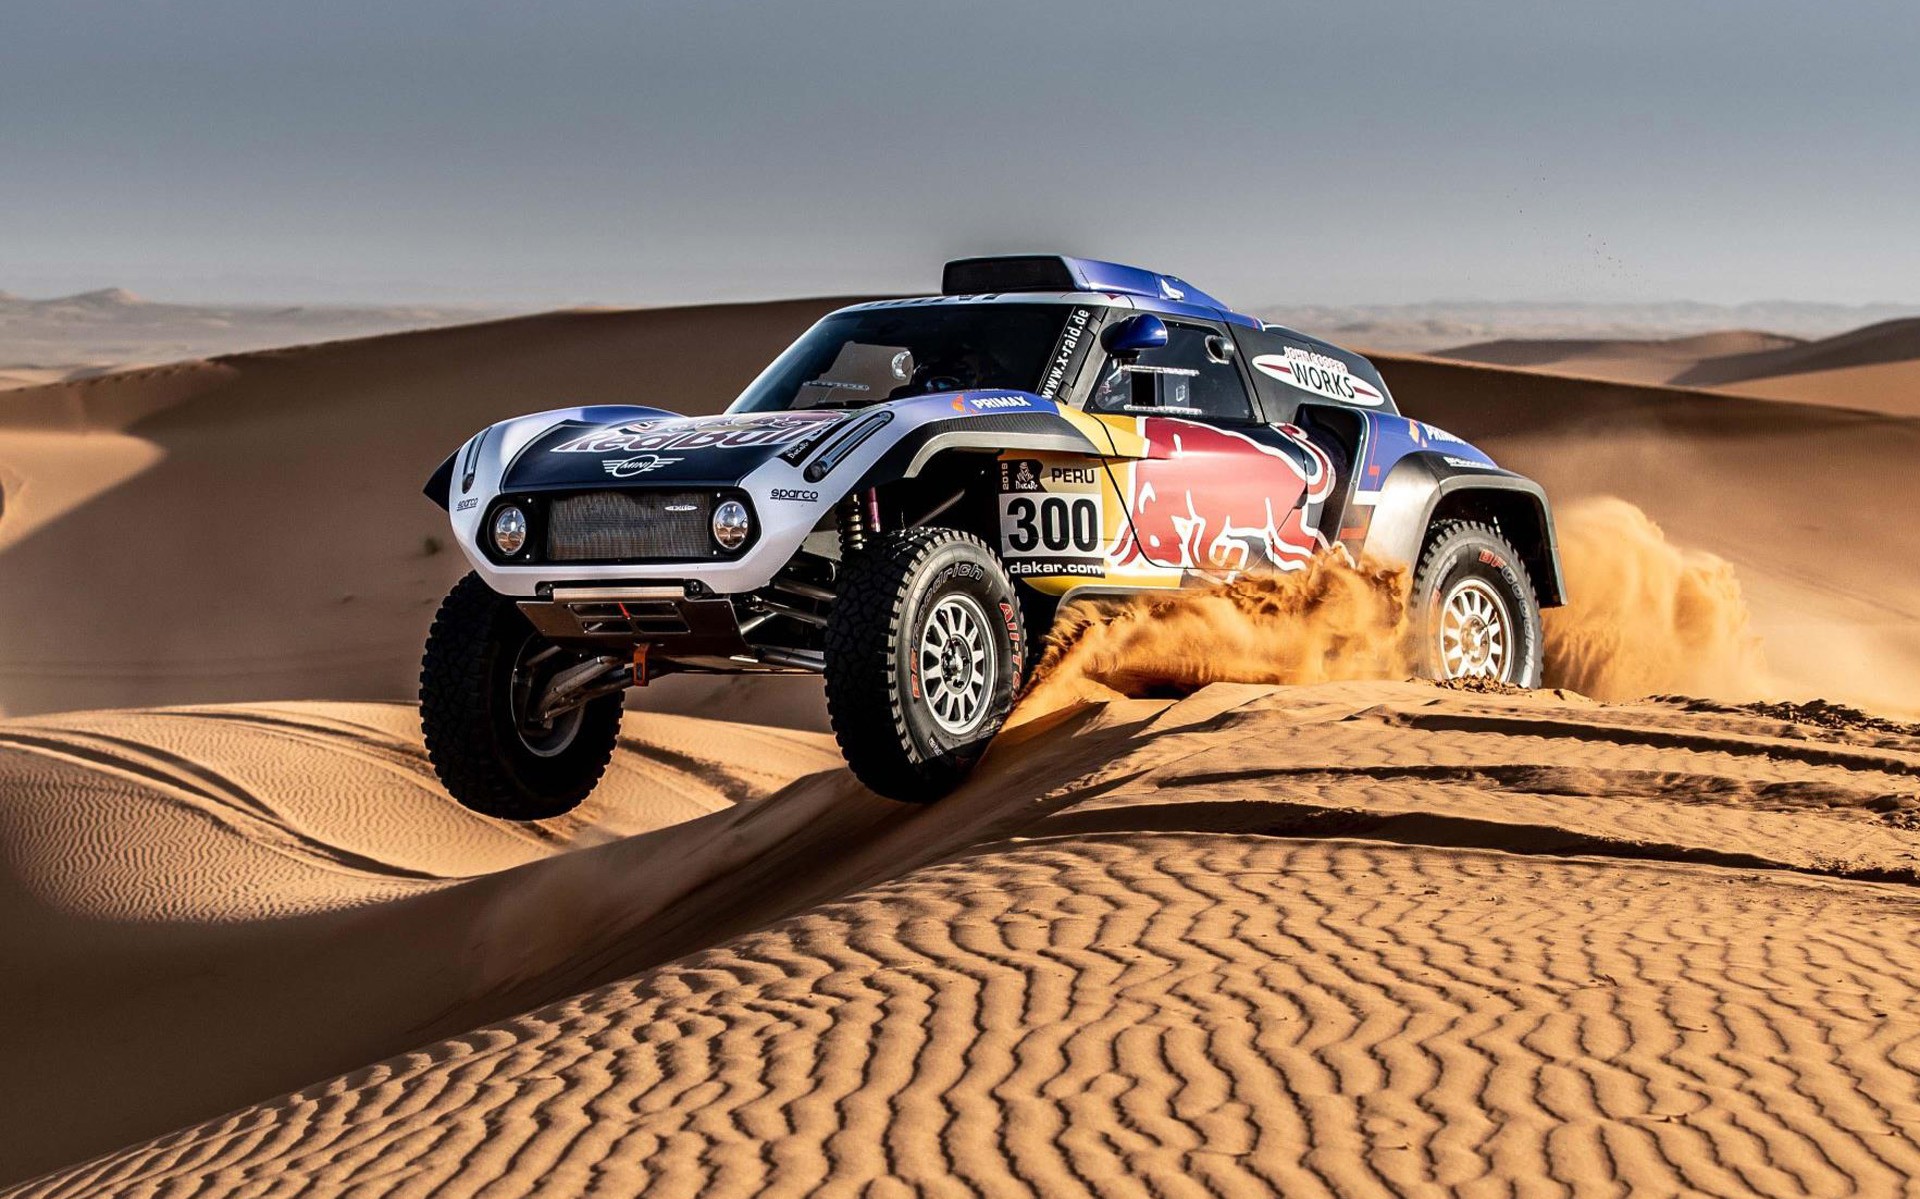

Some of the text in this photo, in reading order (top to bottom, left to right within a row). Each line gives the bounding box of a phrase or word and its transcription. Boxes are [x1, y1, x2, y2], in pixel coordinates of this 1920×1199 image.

[1041, 309, 1090, 400] www.x-raid.de
[1283, 346, 1348, 375] JOHN COOPER
[1289, 360, 1355, 399] WORKS
[970, 396, 1032, 410] PRIMAX
[620, 461, 653, 469] MINI
[1051, 467, 1095, 484] PERU
[770, 488, 819, 502] sparco
[1007, 497, 1098, 552] 300
[1009, 560, 1104, 575] dakar.com
